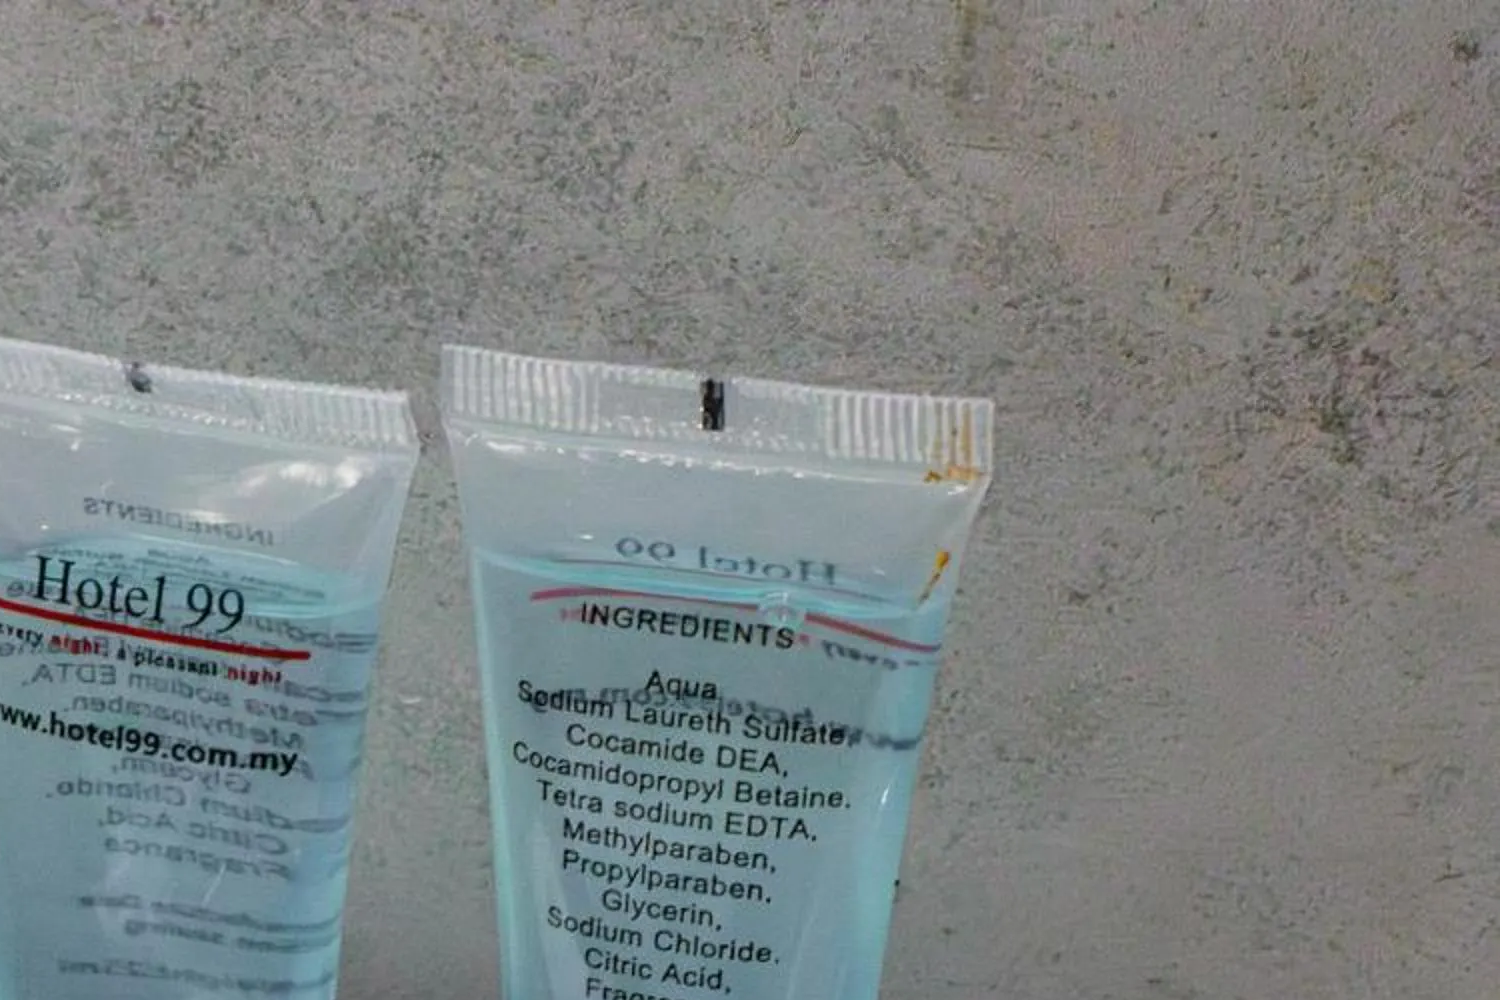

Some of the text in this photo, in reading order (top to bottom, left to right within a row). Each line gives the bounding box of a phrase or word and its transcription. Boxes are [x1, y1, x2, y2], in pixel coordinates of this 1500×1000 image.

[34, 554, 246, 634] Hotel 99
[580, 602, 796, 650] INGREDIENTS
[134, 646, 218, 676] pleasant
[518, 680, 614, 720] Sodium
[625, 698, 731, 736] Laureth
[566, 724, 705, 764] Cocamide
[512, 740, 724, 804] Cocamidopropyl
[537, 779, 603, 812] Tetra
[614, 797, 714, 832] sodium
[546, 906, 643, 947] Sodium
[584, 947, 653, 981] Citric
